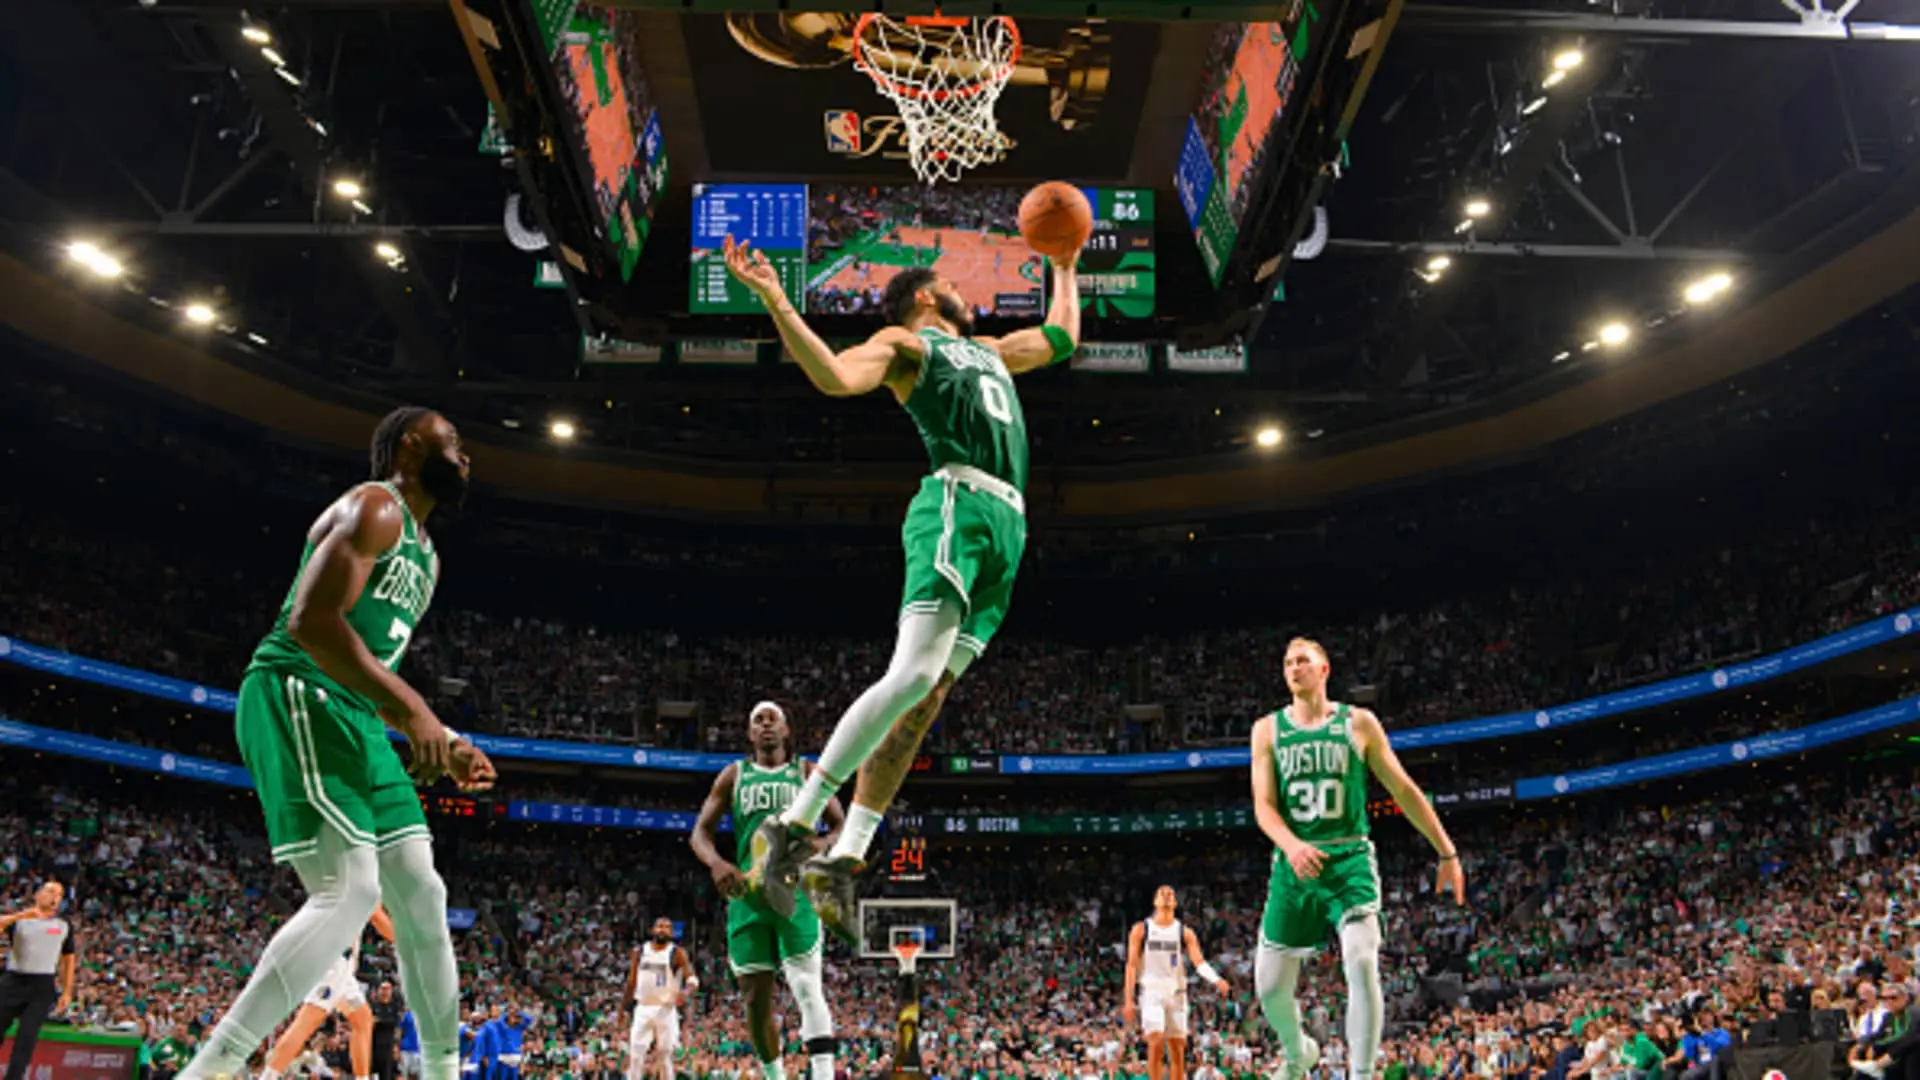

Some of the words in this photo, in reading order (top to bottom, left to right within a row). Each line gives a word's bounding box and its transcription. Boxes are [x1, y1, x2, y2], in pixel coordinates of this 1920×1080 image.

[1112, 202, 1140, 221] 86
[979, 375, 1013, 424] 0
[379, 617, 412, 669] 7
[1279, 740, 1349, 780] BOSTON
[1287, 779, 1344, 822] 30
[891, 849, 923, 871] 24
